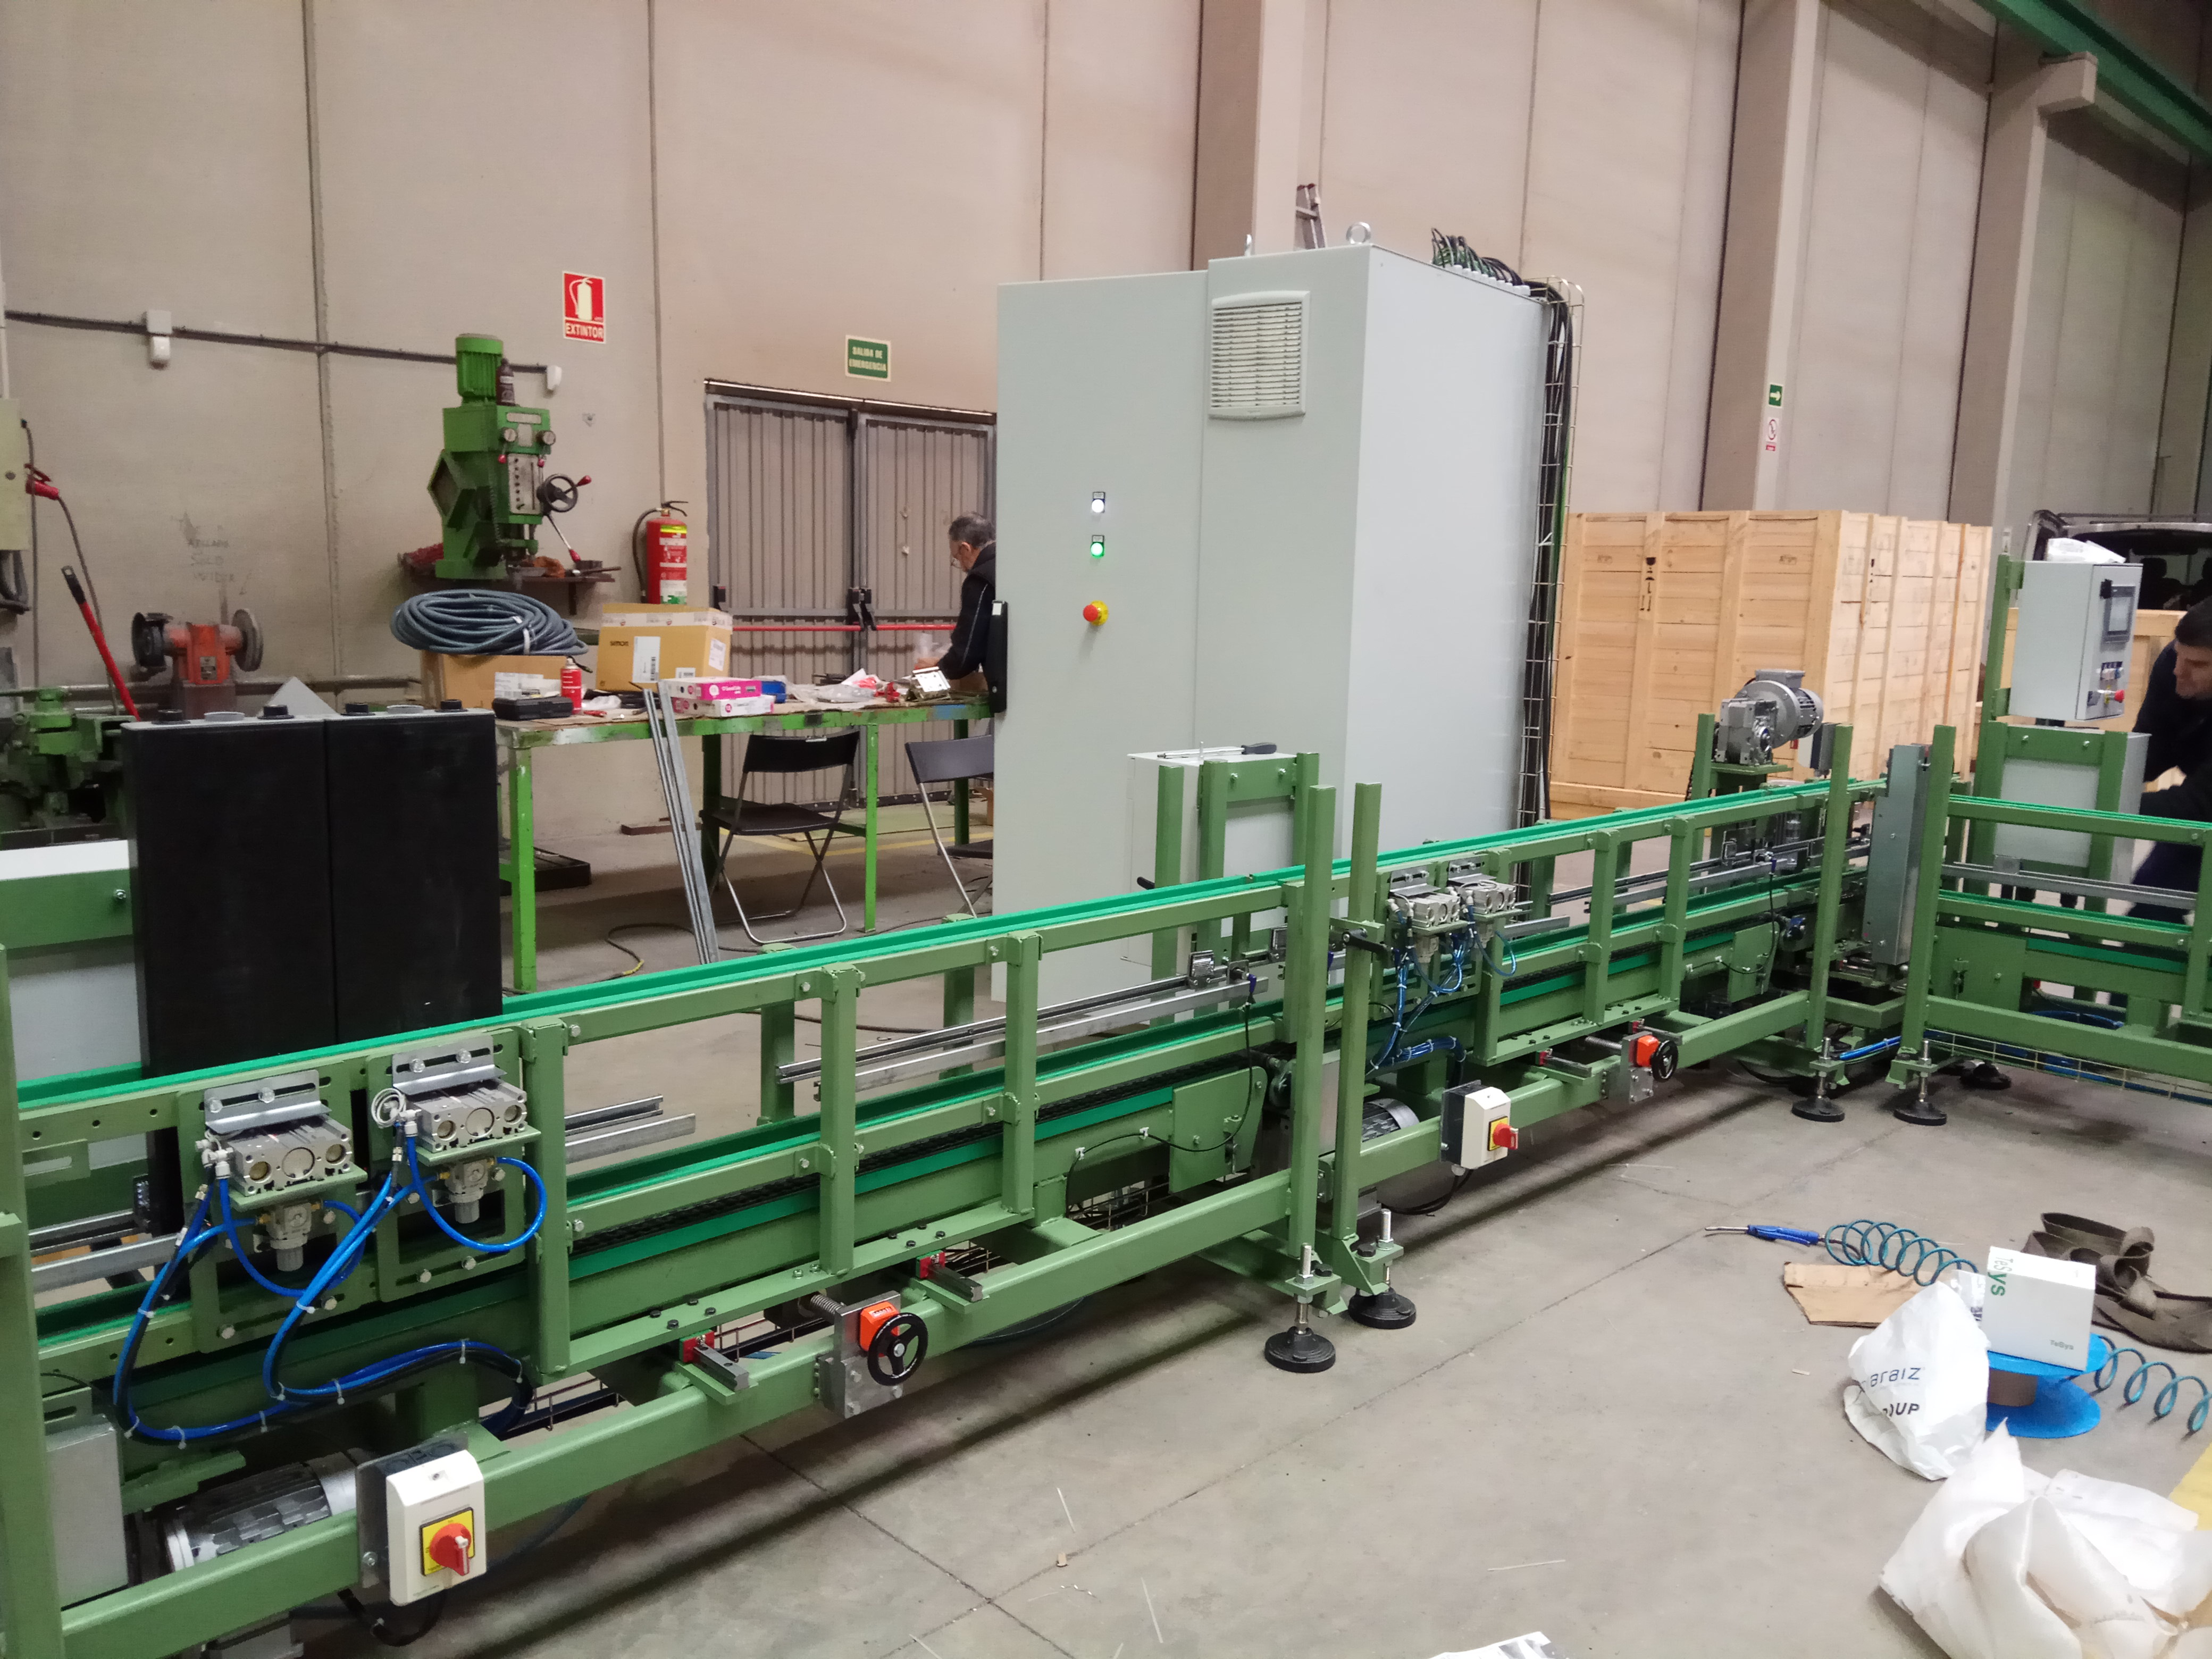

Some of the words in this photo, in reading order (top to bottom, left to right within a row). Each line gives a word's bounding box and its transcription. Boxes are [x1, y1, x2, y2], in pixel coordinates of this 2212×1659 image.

[566, 323, 604, 338] EXTINTOR
[852, 347, 874, 357] SALIDA
[875, 350, 883, 359] DE
[848, 358, 887, 371] EMERGENCIA
[1987, 1256, 2014, 1296] TeSys
[1861, 1367, 1921, 1387] araiz
[1883, 1402, 1920, 1417] OUP
